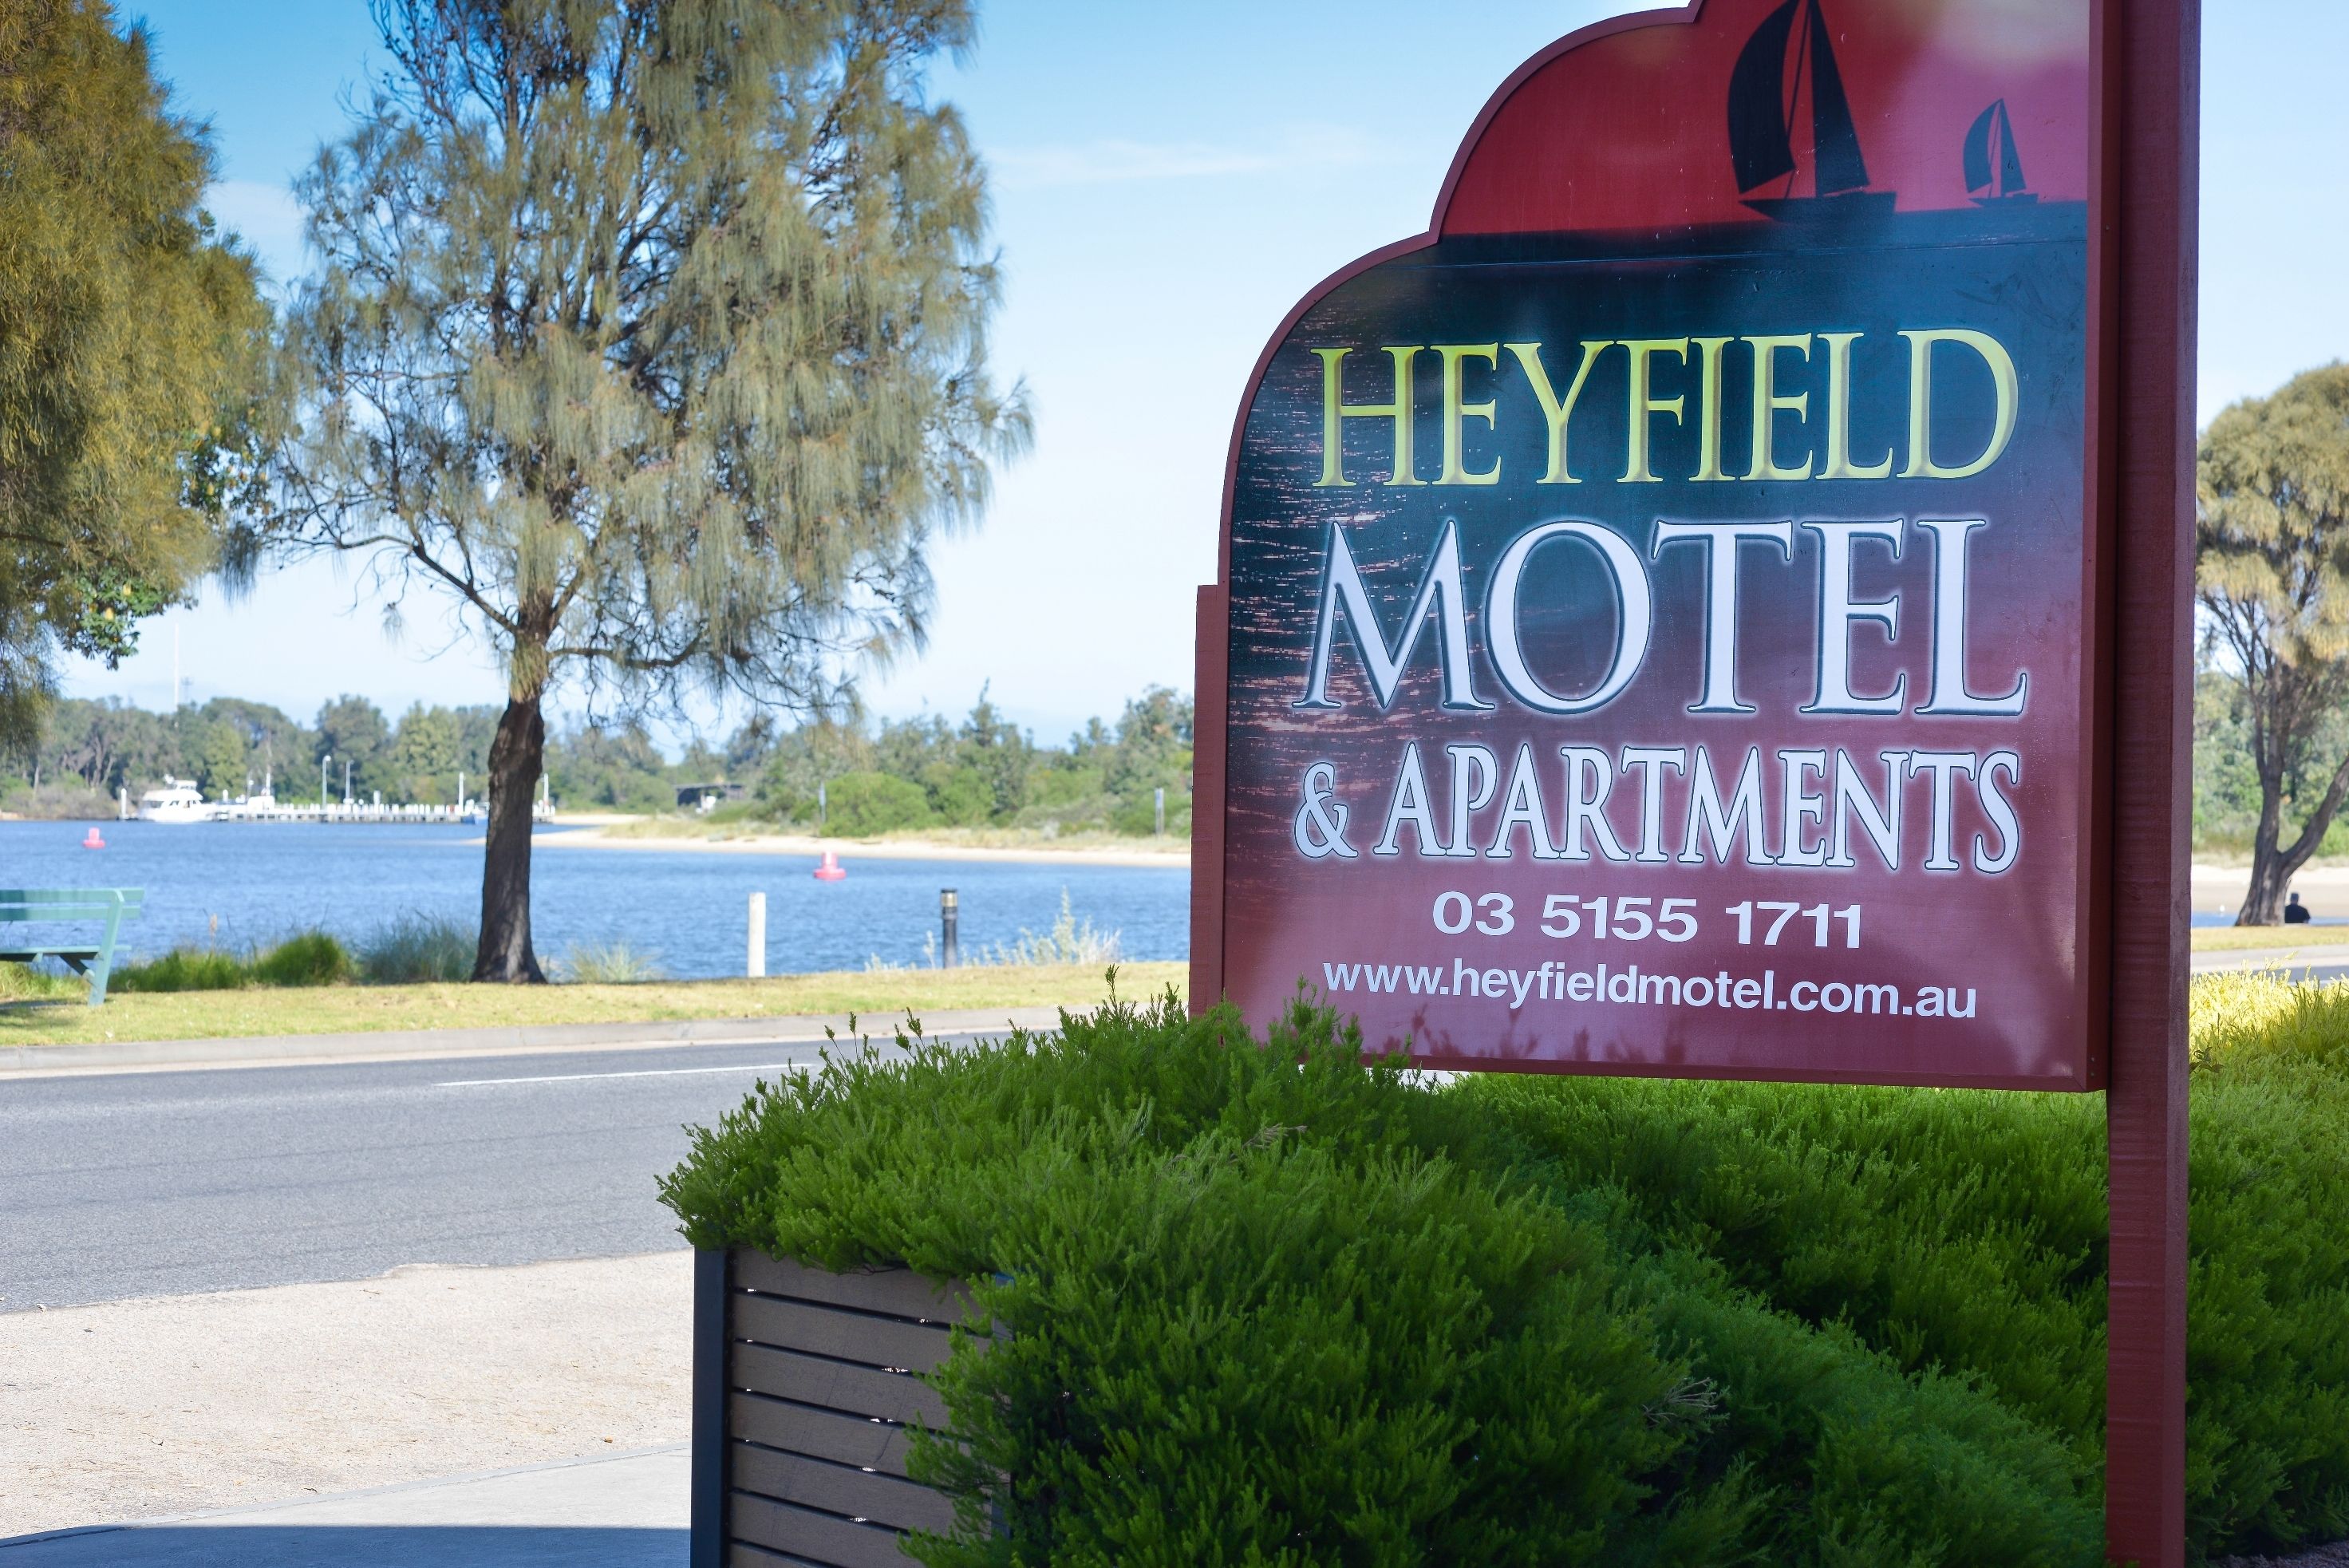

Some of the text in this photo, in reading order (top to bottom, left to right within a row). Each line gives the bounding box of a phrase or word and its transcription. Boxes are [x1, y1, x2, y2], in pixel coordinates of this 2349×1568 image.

[1310, 328, 2019, 488] HEYFIELD
[1292, 518, 2029, 716] MOTEL
[1293, 741, 2022, 875] & APARTMENTS
[1433, 891, 1862, 950] 03 5155 1711
[1321, 958, 1978, 1019] www.heyfieldmotel.com.au
